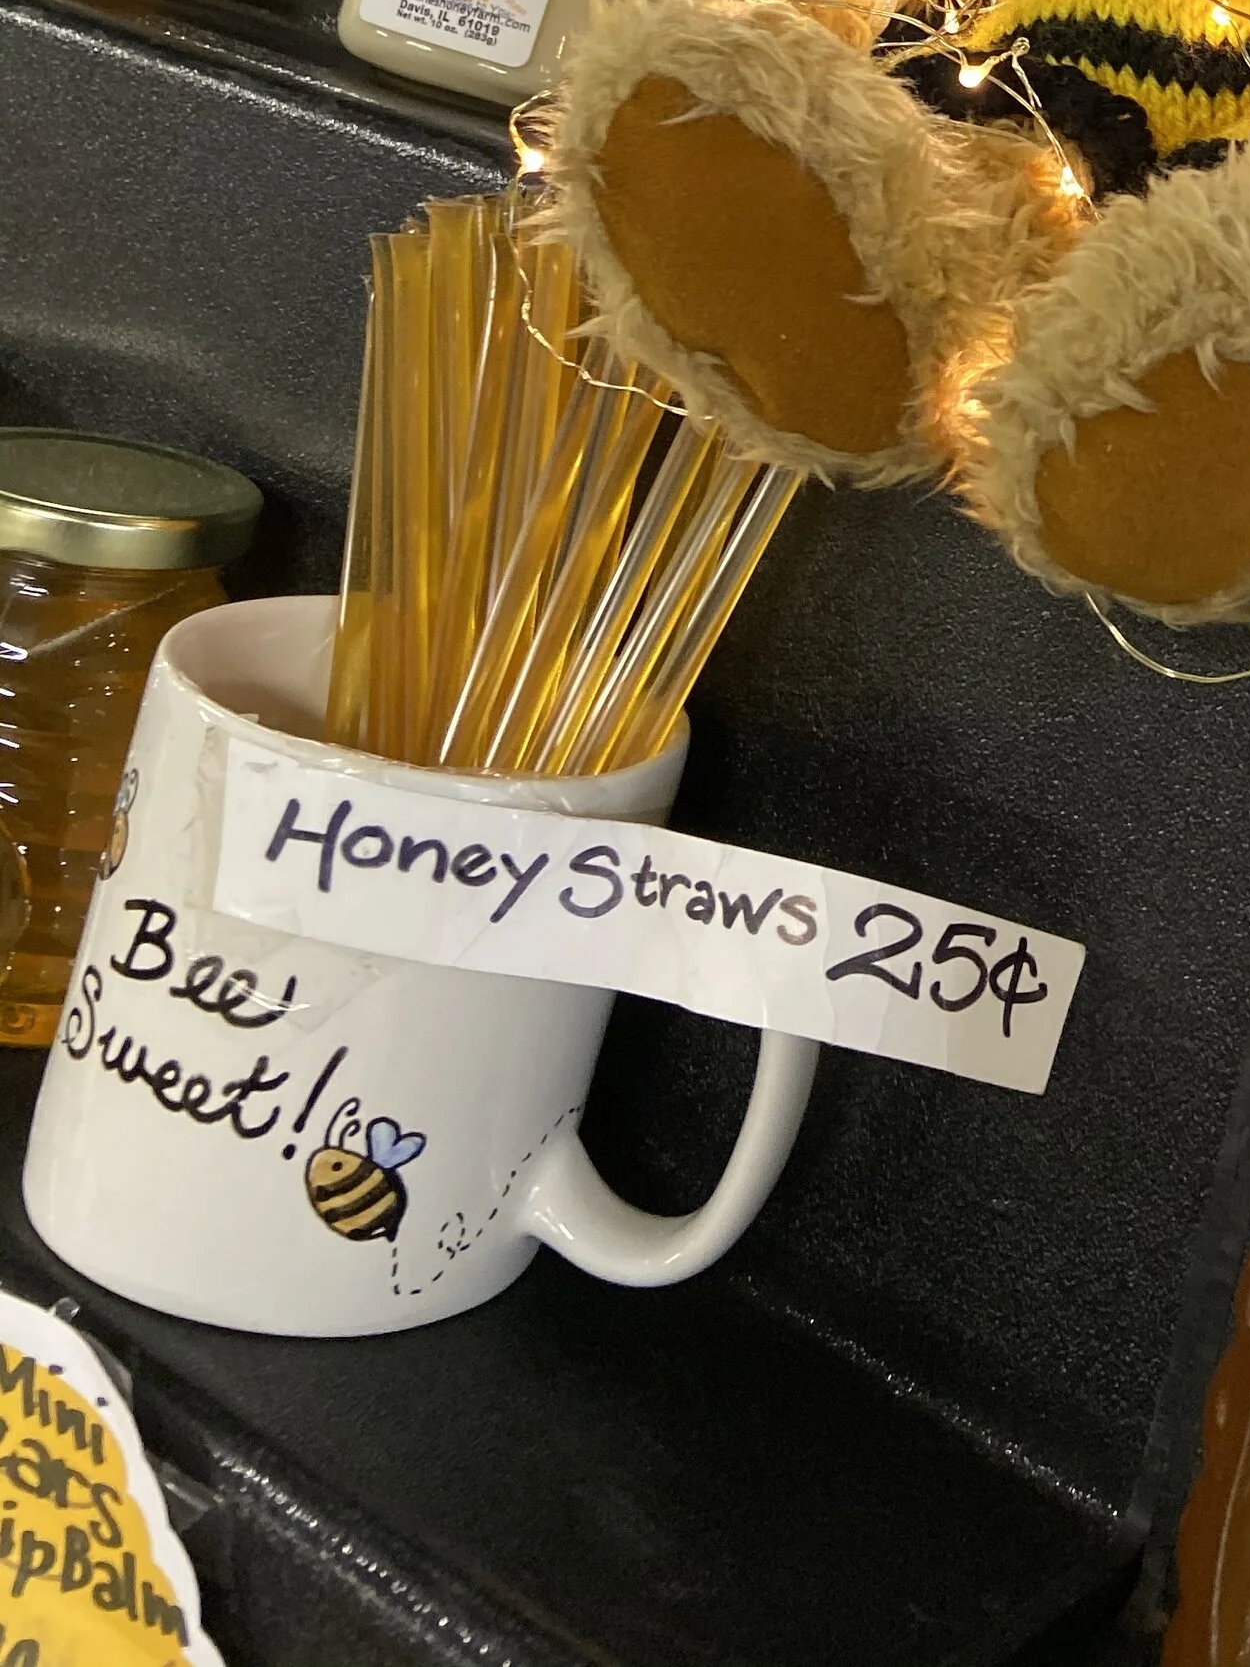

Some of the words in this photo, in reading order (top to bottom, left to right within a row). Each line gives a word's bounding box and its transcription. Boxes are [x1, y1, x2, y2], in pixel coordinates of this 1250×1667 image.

[438, 10, 450, 23] IL
[112, 898, 298, 1026] Bee
[264, 796, 550, 924] Honey
[558, 844, 817, 945] Straws
[824, 902, 1049, 1039] 25¢
[62, 964, 347, 1159] Sweet!
